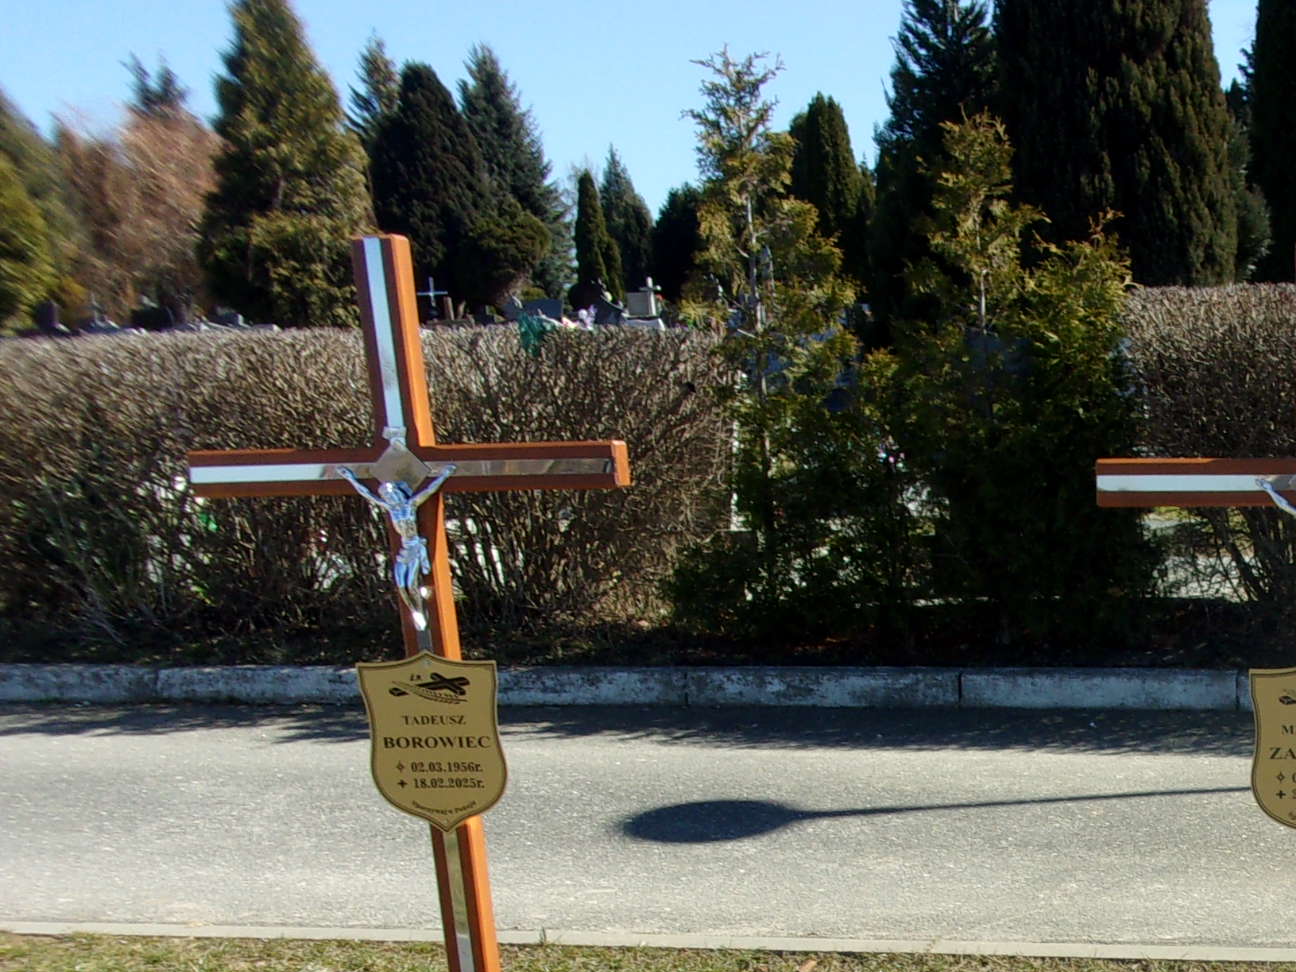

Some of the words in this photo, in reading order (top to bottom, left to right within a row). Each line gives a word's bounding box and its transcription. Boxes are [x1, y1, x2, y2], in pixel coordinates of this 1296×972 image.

[401, 714, 466, 726] TADEUSZ
[383, 735, 491, 749] BOROWIEC
[413, 777, 486, 790] 18.02.2025r.
